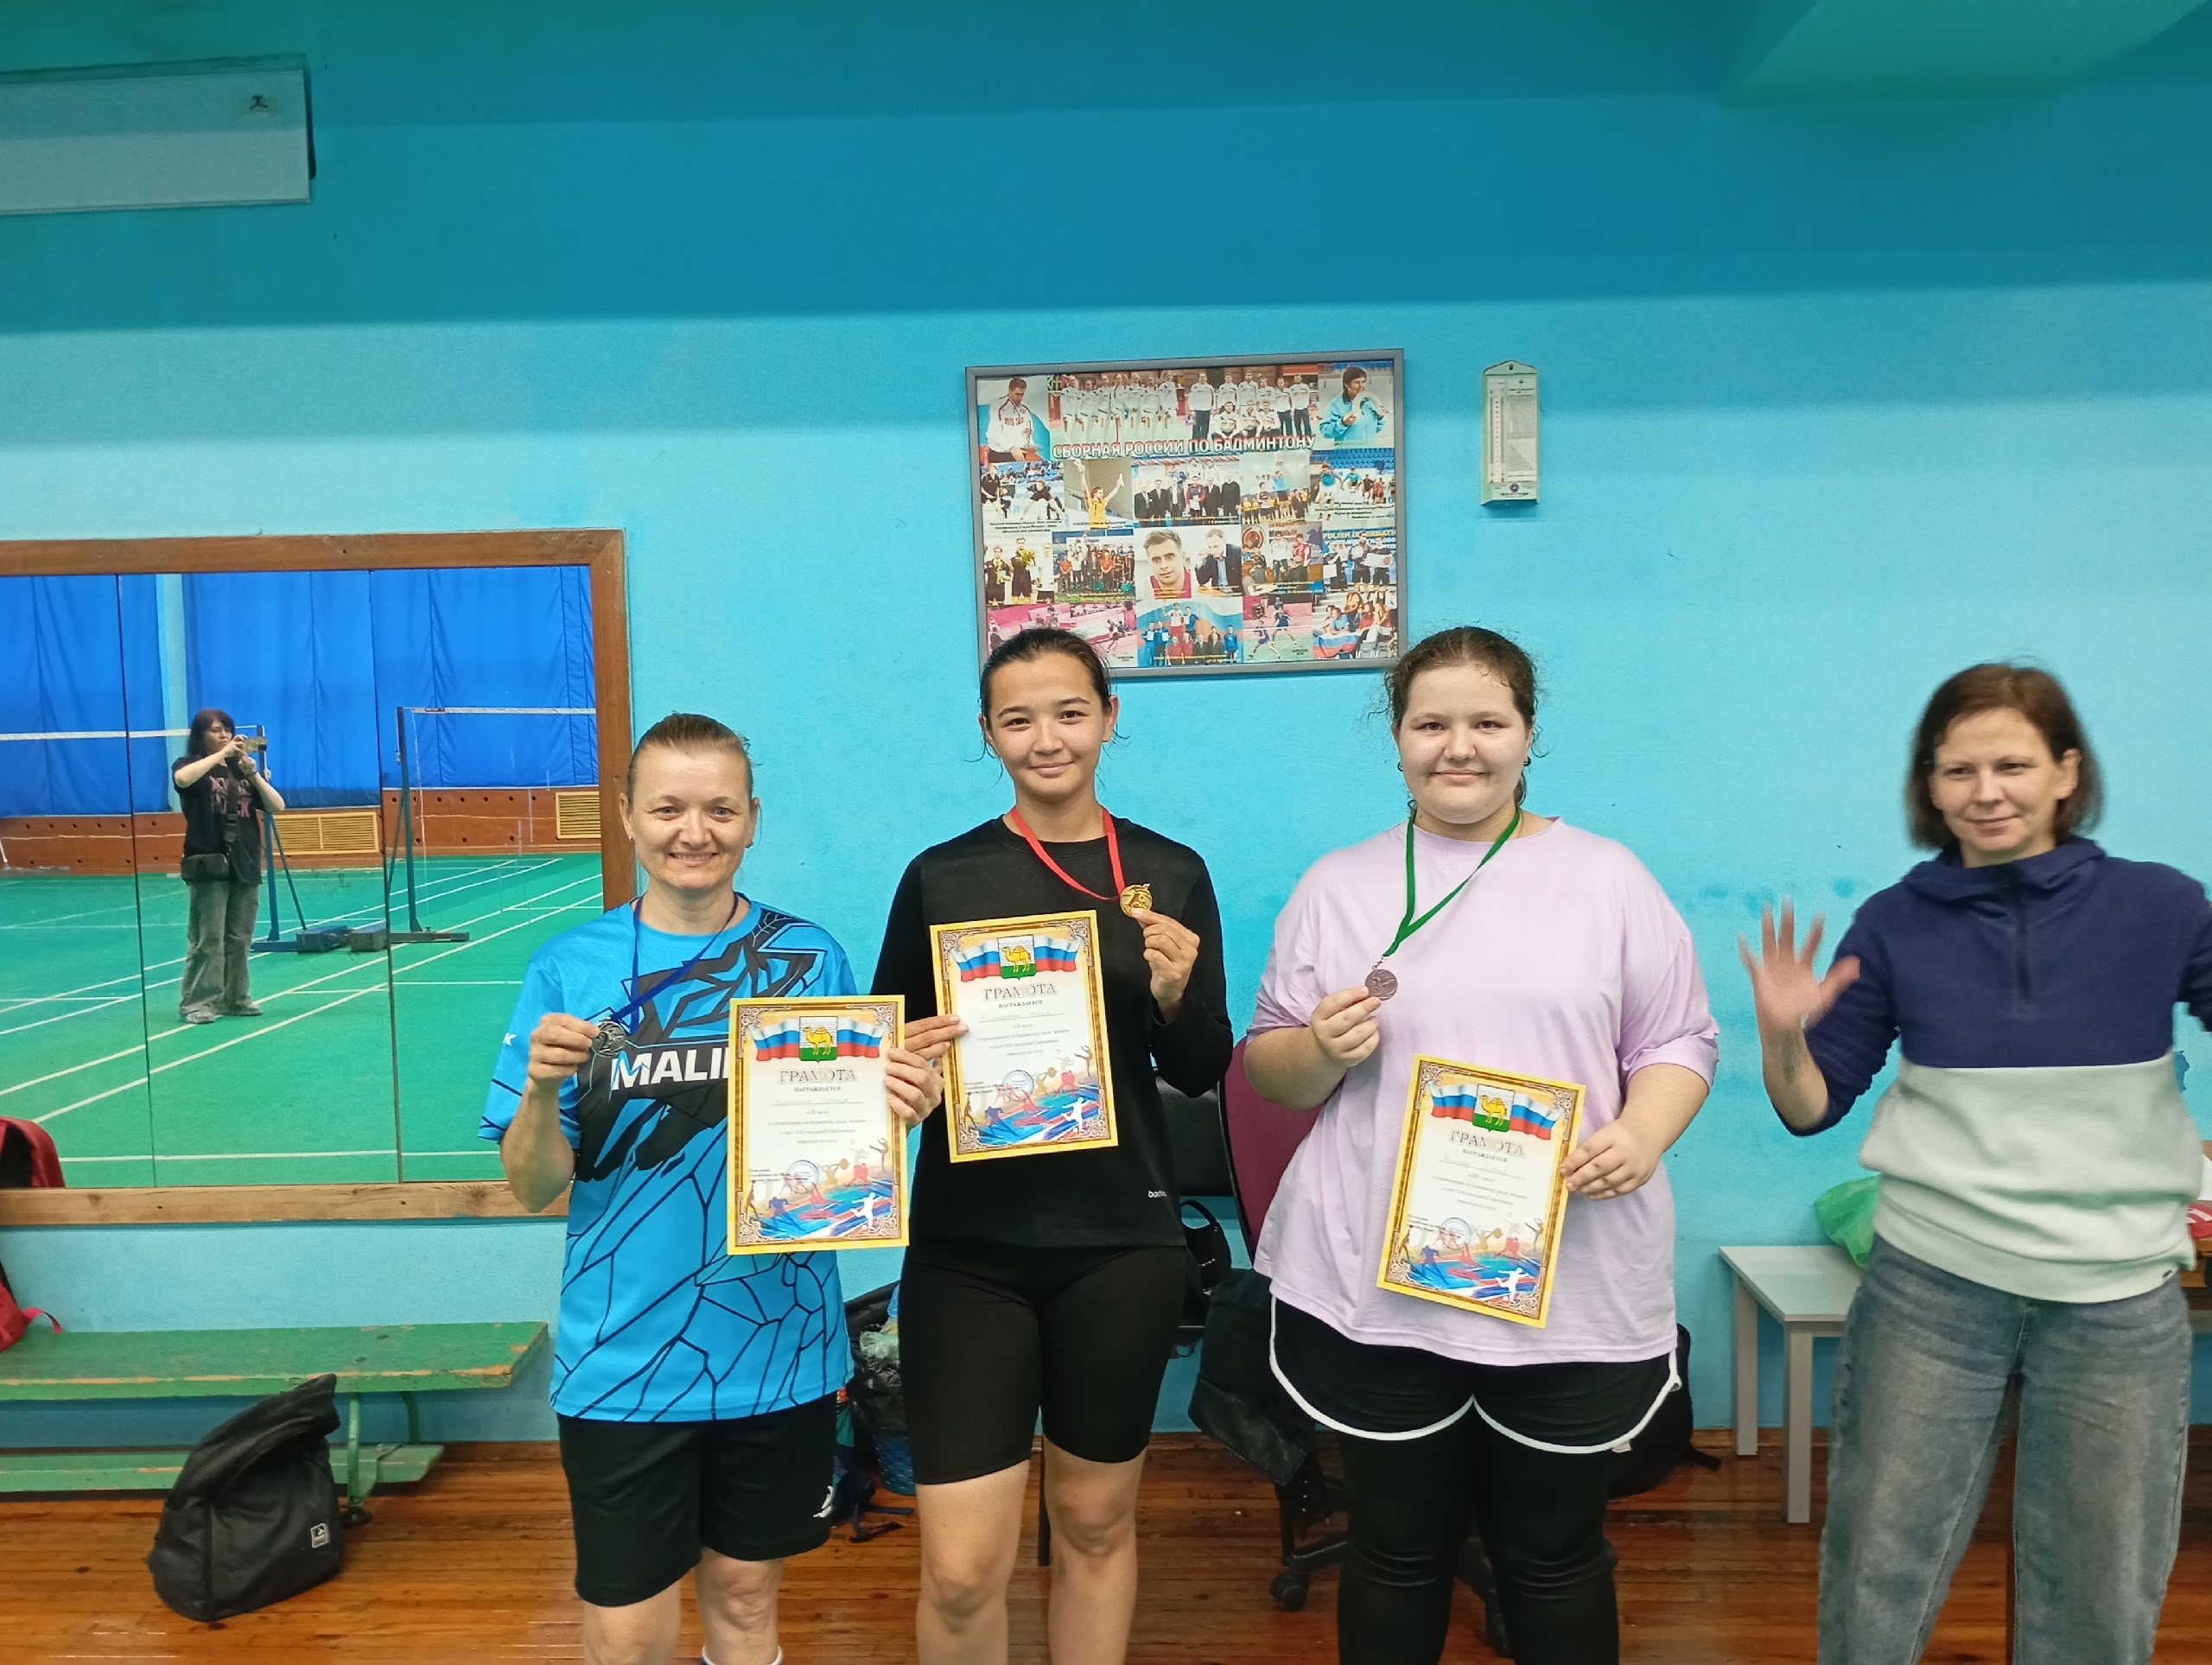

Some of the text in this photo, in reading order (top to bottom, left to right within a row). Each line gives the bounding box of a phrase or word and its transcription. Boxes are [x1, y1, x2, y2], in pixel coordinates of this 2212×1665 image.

[1052, 435, 1316, 459] СБОРНАЯ РОССИИ ПО БАДМИНТОНУ
[984, 983, 1057, 1001] ГРАМОТА
[779, 1069, 857, 1083] ГРАМОТА
[1450, 1129, 1523, 1153] ГРАМОТА
